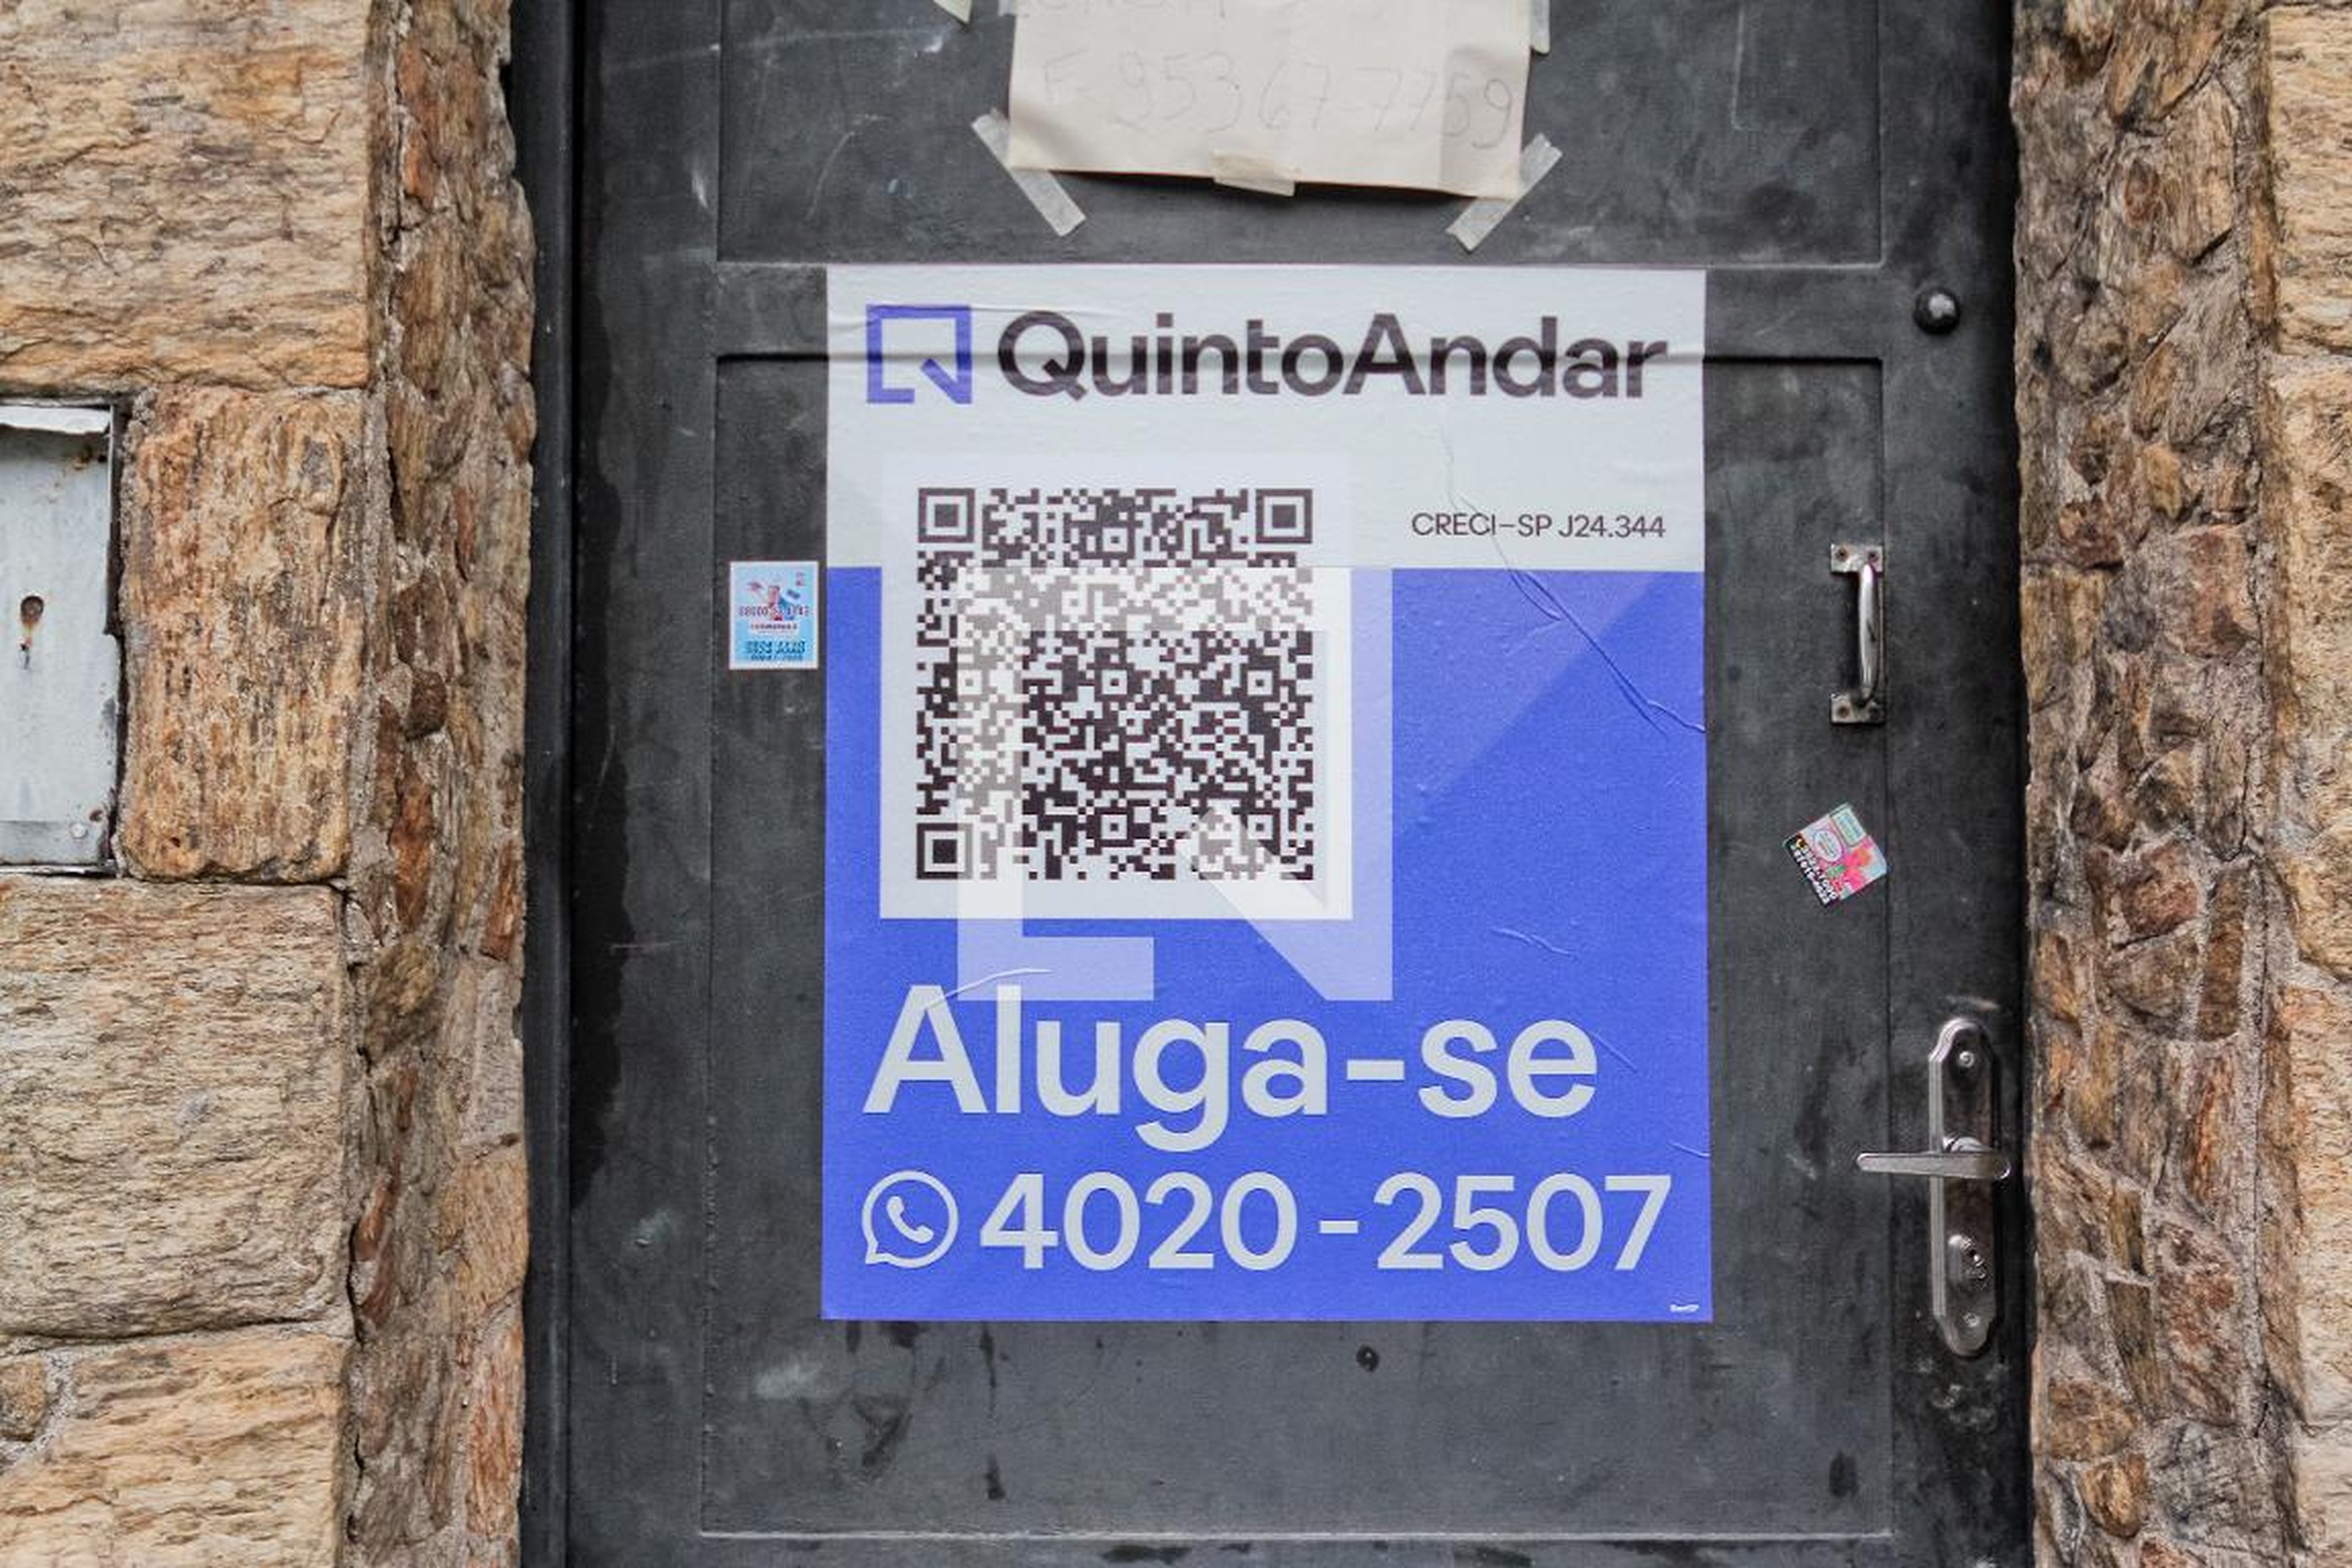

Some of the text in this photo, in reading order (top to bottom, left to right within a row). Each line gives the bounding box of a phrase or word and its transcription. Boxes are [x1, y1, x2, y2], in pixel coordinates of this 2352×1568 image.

[995, 311, 1668, 400] QuintoAndar
[1411, 512, 1666, 538] CRECI-SP J24.344
[863, 984, 1597, 1152] Aluga-se
